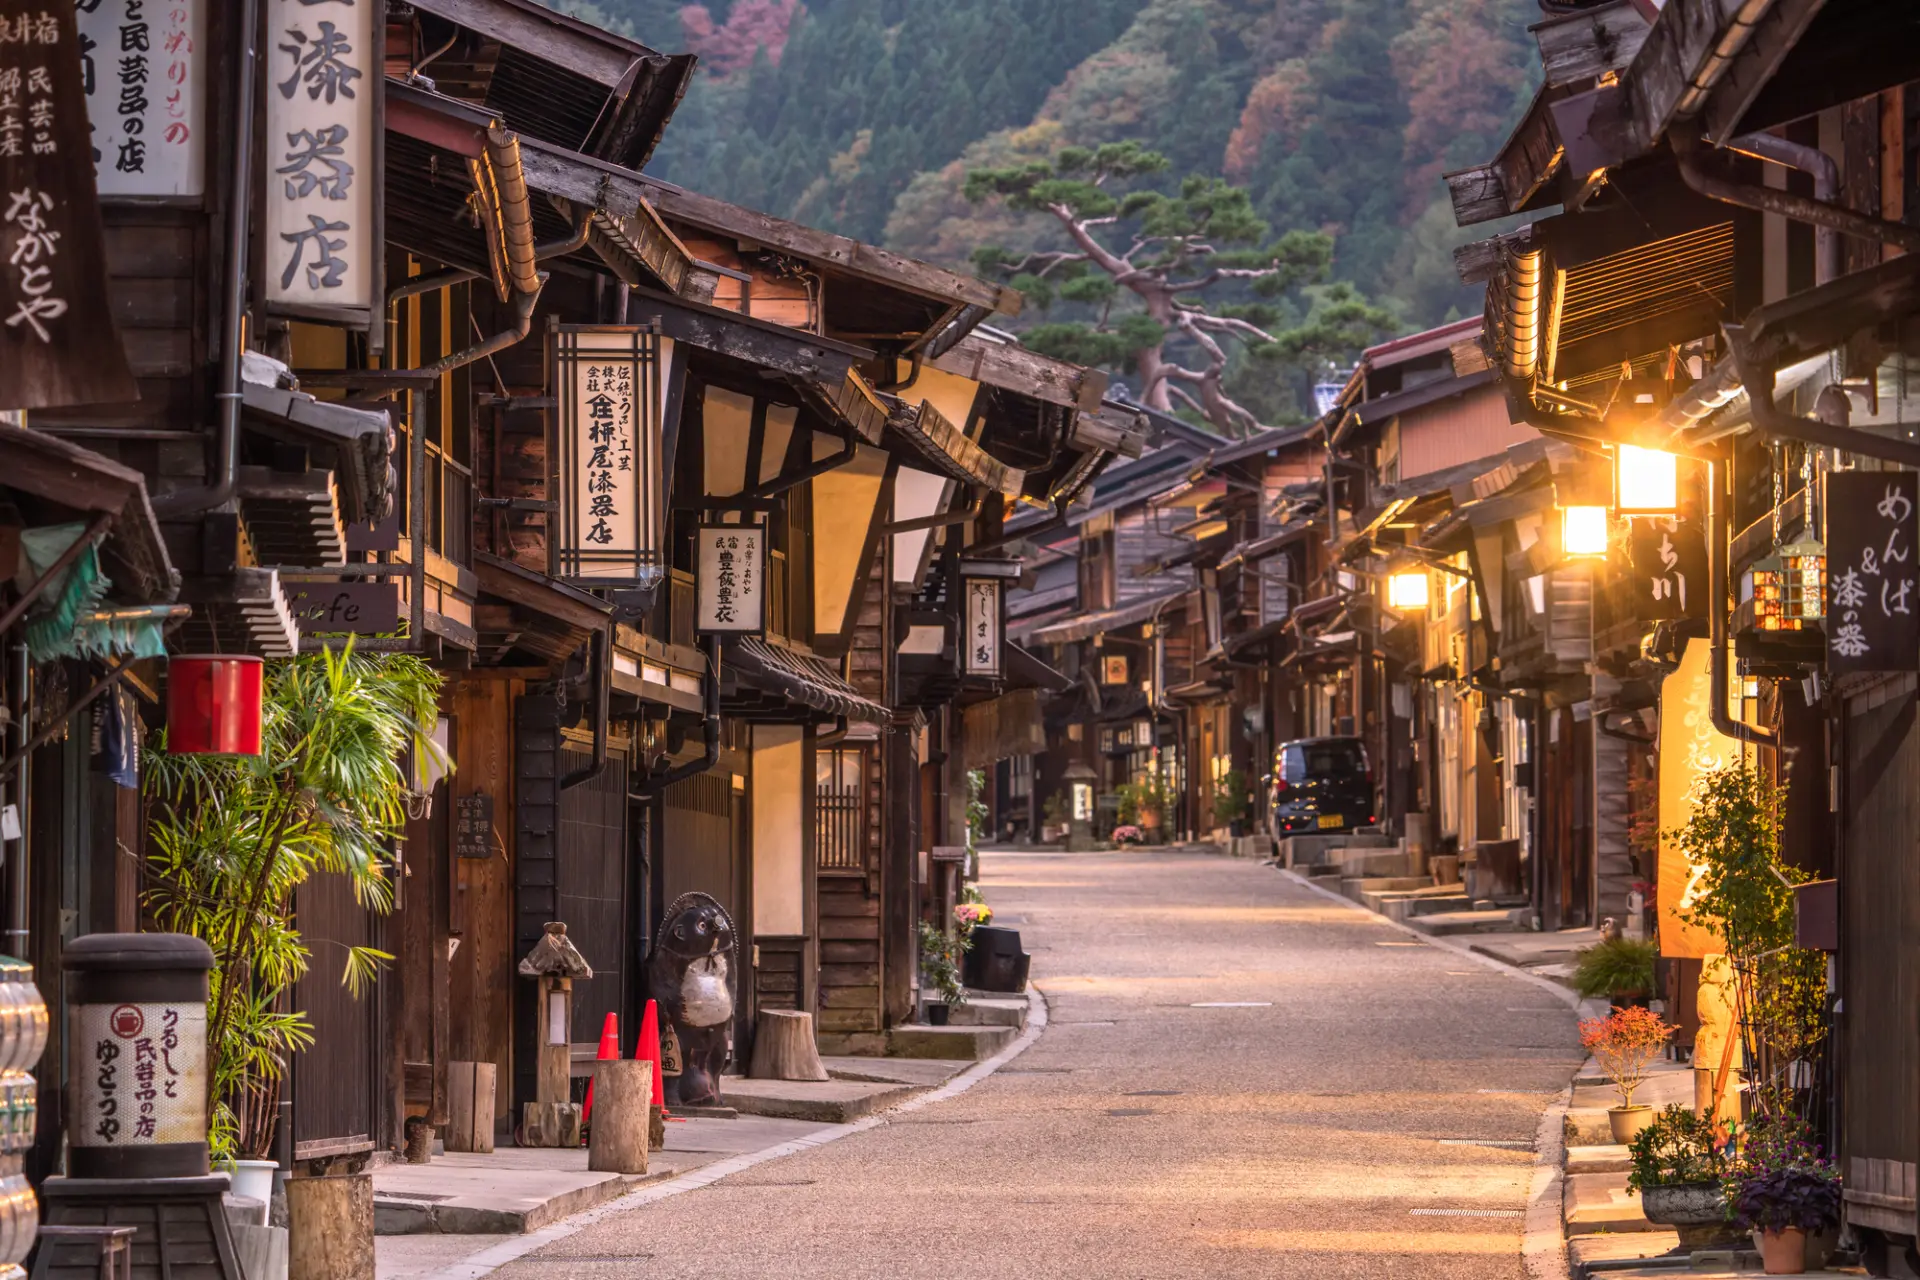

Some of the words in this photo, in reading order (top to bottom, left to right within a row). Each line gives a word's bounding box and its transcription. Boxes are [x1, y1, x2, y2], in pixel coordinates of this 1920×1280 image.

[28, 66, 57, 155] 民芸品
[276, 0, 363, 290] 漆器店
[5, 187, 68, 343] ながとや
[617, 365, 632, 472] 伝統うるし工芸
[1861, 546, 1880, 575] &
[1831, 566, 1870, 657] 漆の器
[96, 1039, 121, 1143] ゆとうや
[160, 1008, 179, 1099] うるしと
